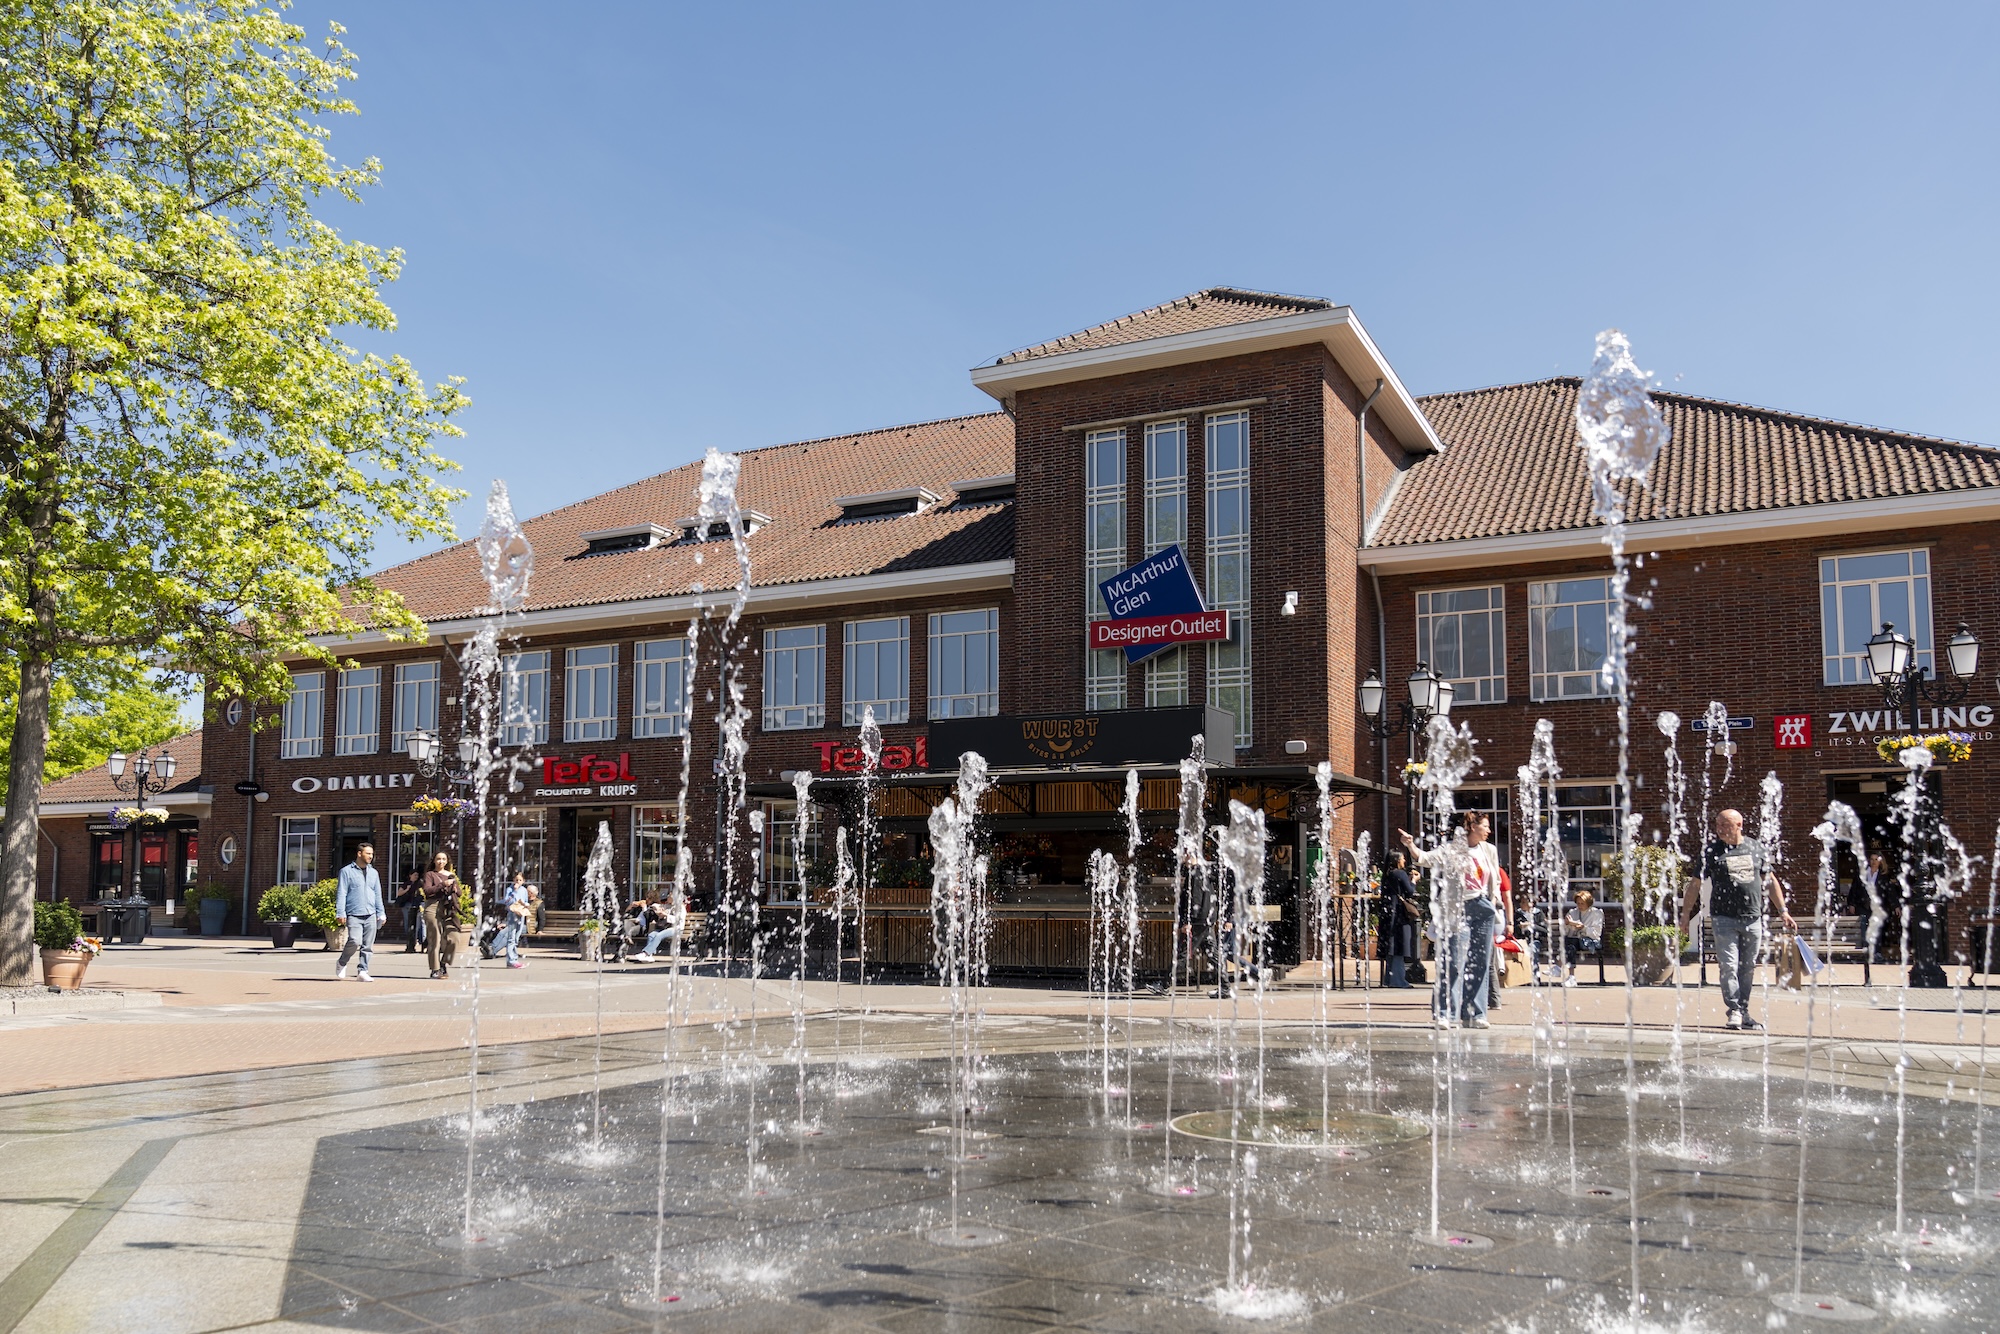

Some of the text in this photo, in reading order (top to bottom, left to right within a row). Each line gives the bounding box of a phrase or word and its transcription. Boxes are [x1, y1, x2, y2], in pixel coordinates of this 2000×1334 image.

[1107, 553, 1179, 600] McArthur
[1114, 591, 1151, 616] Glen
[1098, 616, 1221, 643] Designer Outlet
[1828, 705, 1994, 734] ZWILLING
[1829, 737, 1852, 747] IT'S
[1858, 737, 1867, 746] A
[541, 752, 637, 785] Tefal
[327, 773, 415, 791] OAKLEY
[600, 784, 637, 797] KRUPS
